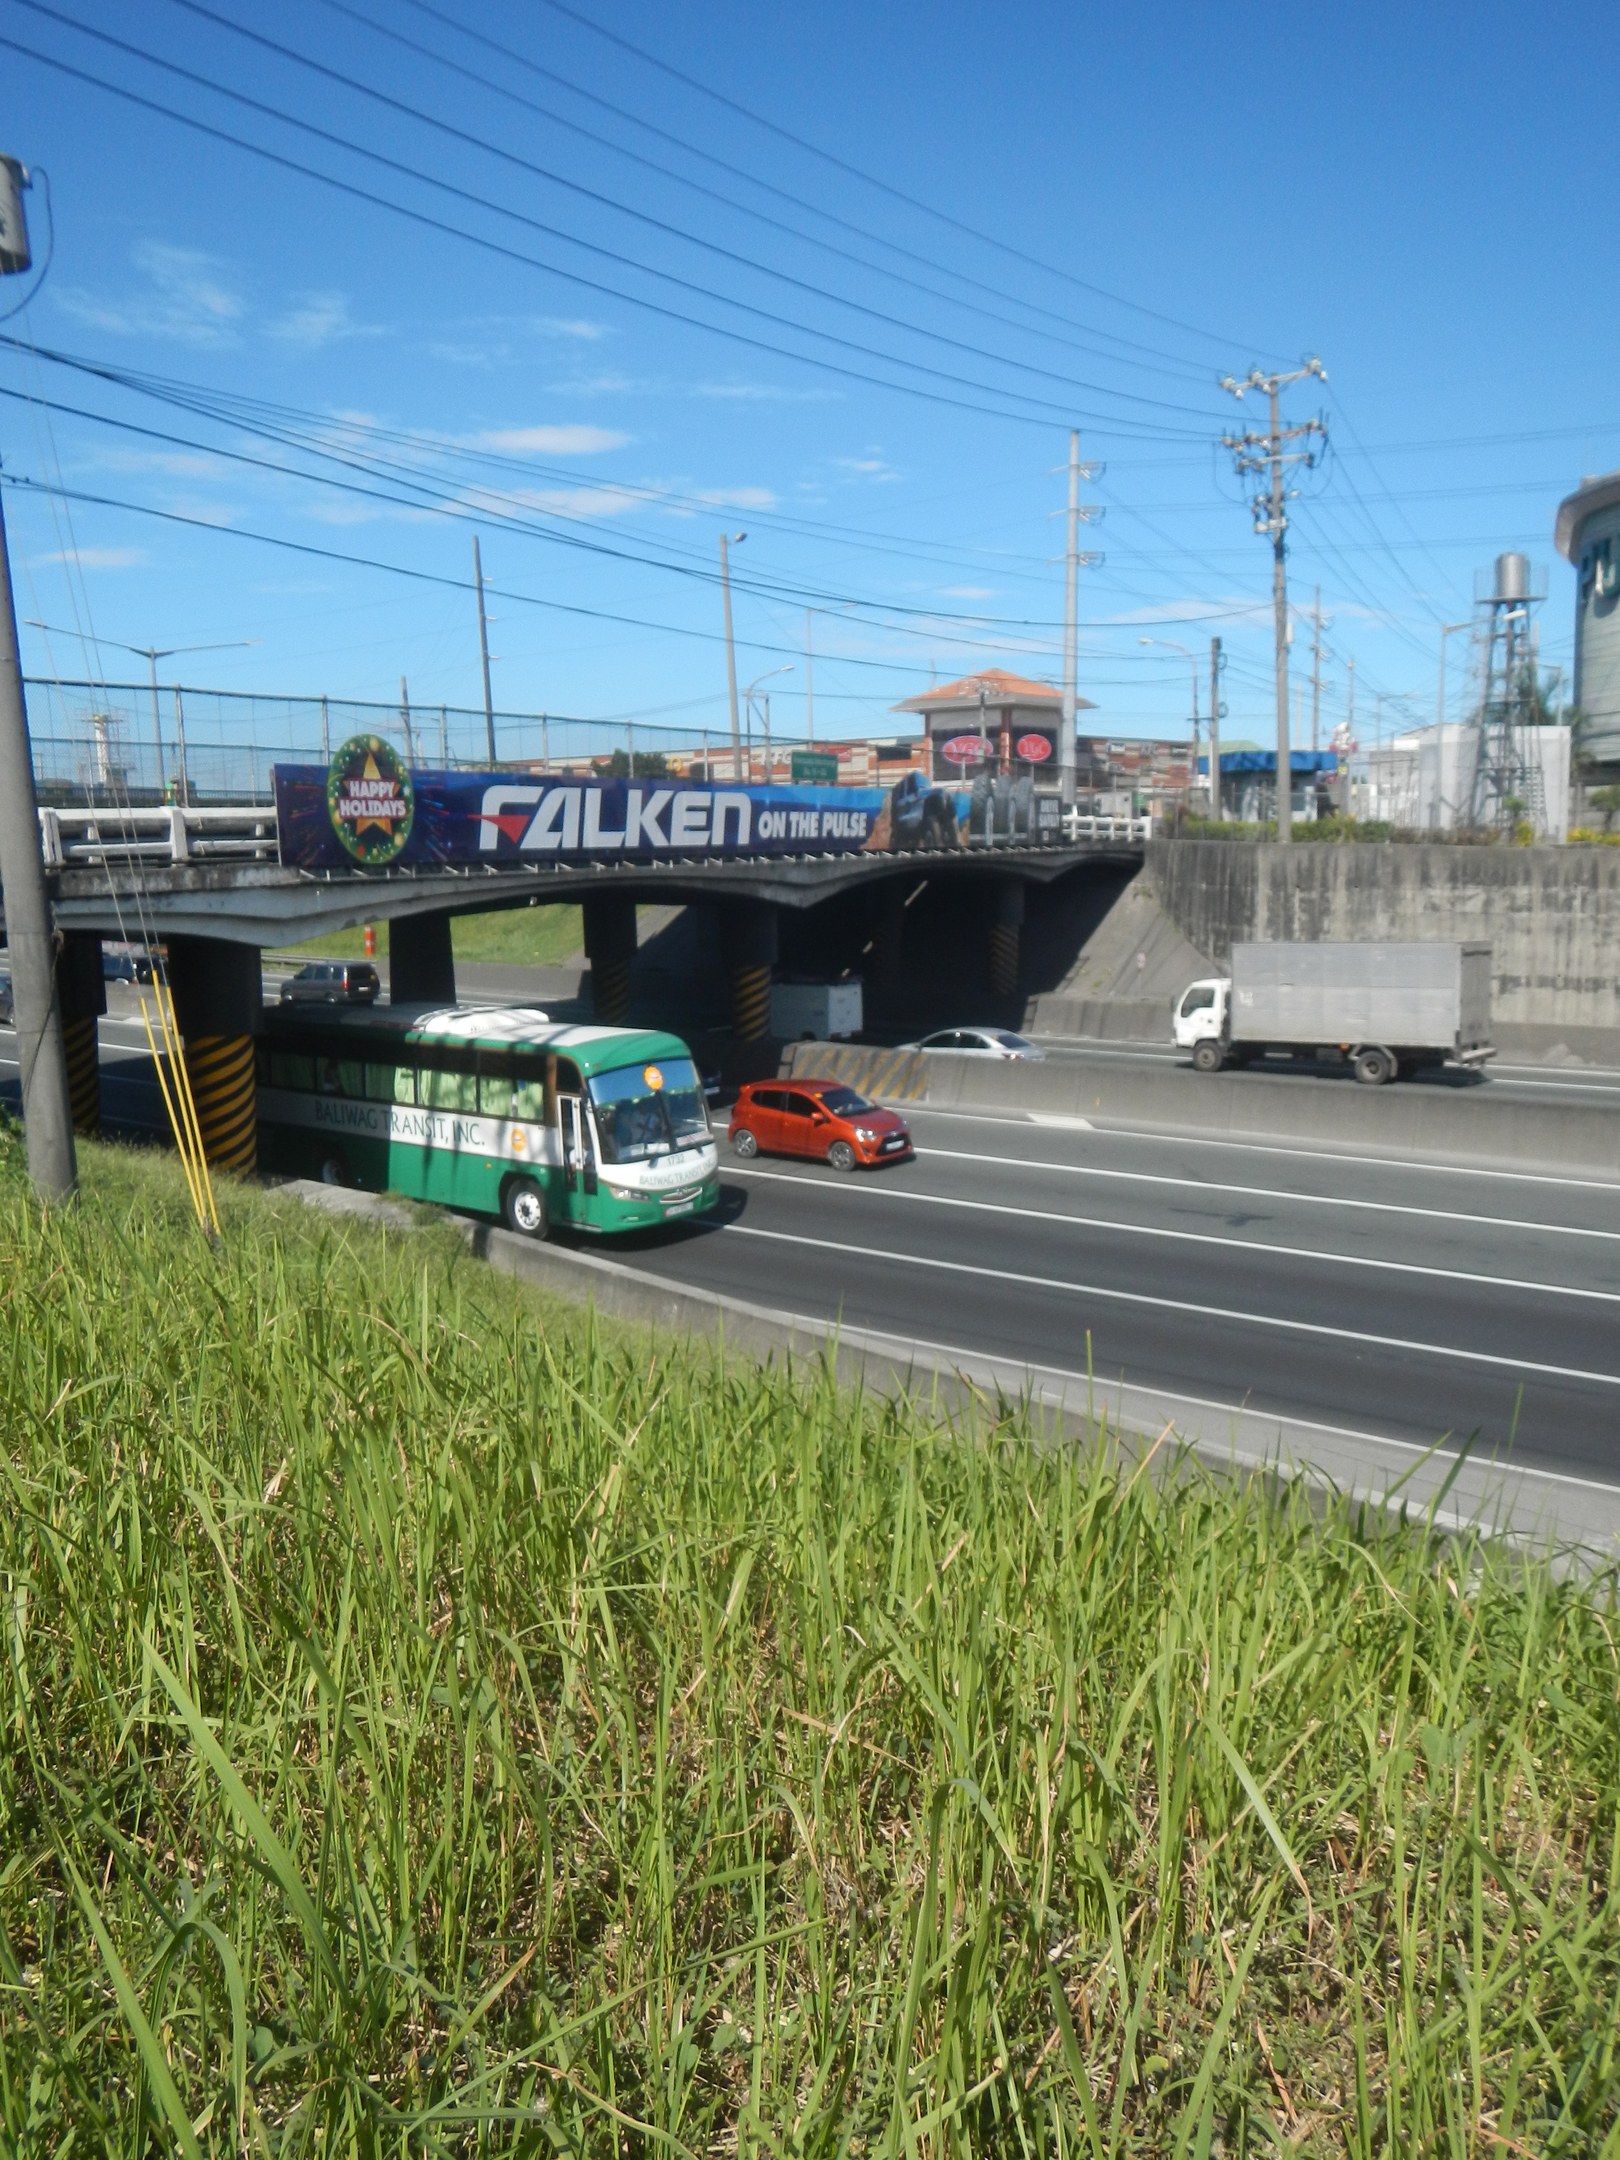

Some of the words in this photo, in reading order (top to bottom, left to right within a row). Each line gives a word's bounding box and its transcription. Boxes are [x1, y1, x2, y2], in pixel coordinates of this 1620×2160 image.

[349, 780, 395, 798] HAPPY
[339, 799, 406, 817] HOLIDAYS
[478, 784, 752, 852] FALKEN
[758, 810, 787, 839] ON
[789, 811, 819, 839] THE
[822, 811, 867, 838] PULSE
[315, 1099, 377, 1129] BALIWAG
[383, 1111, 449, 1144] TRANSIT,
[453, 1120, 485, 1146] INC.
[639, 1174, 674, 1185] BALIWAG
